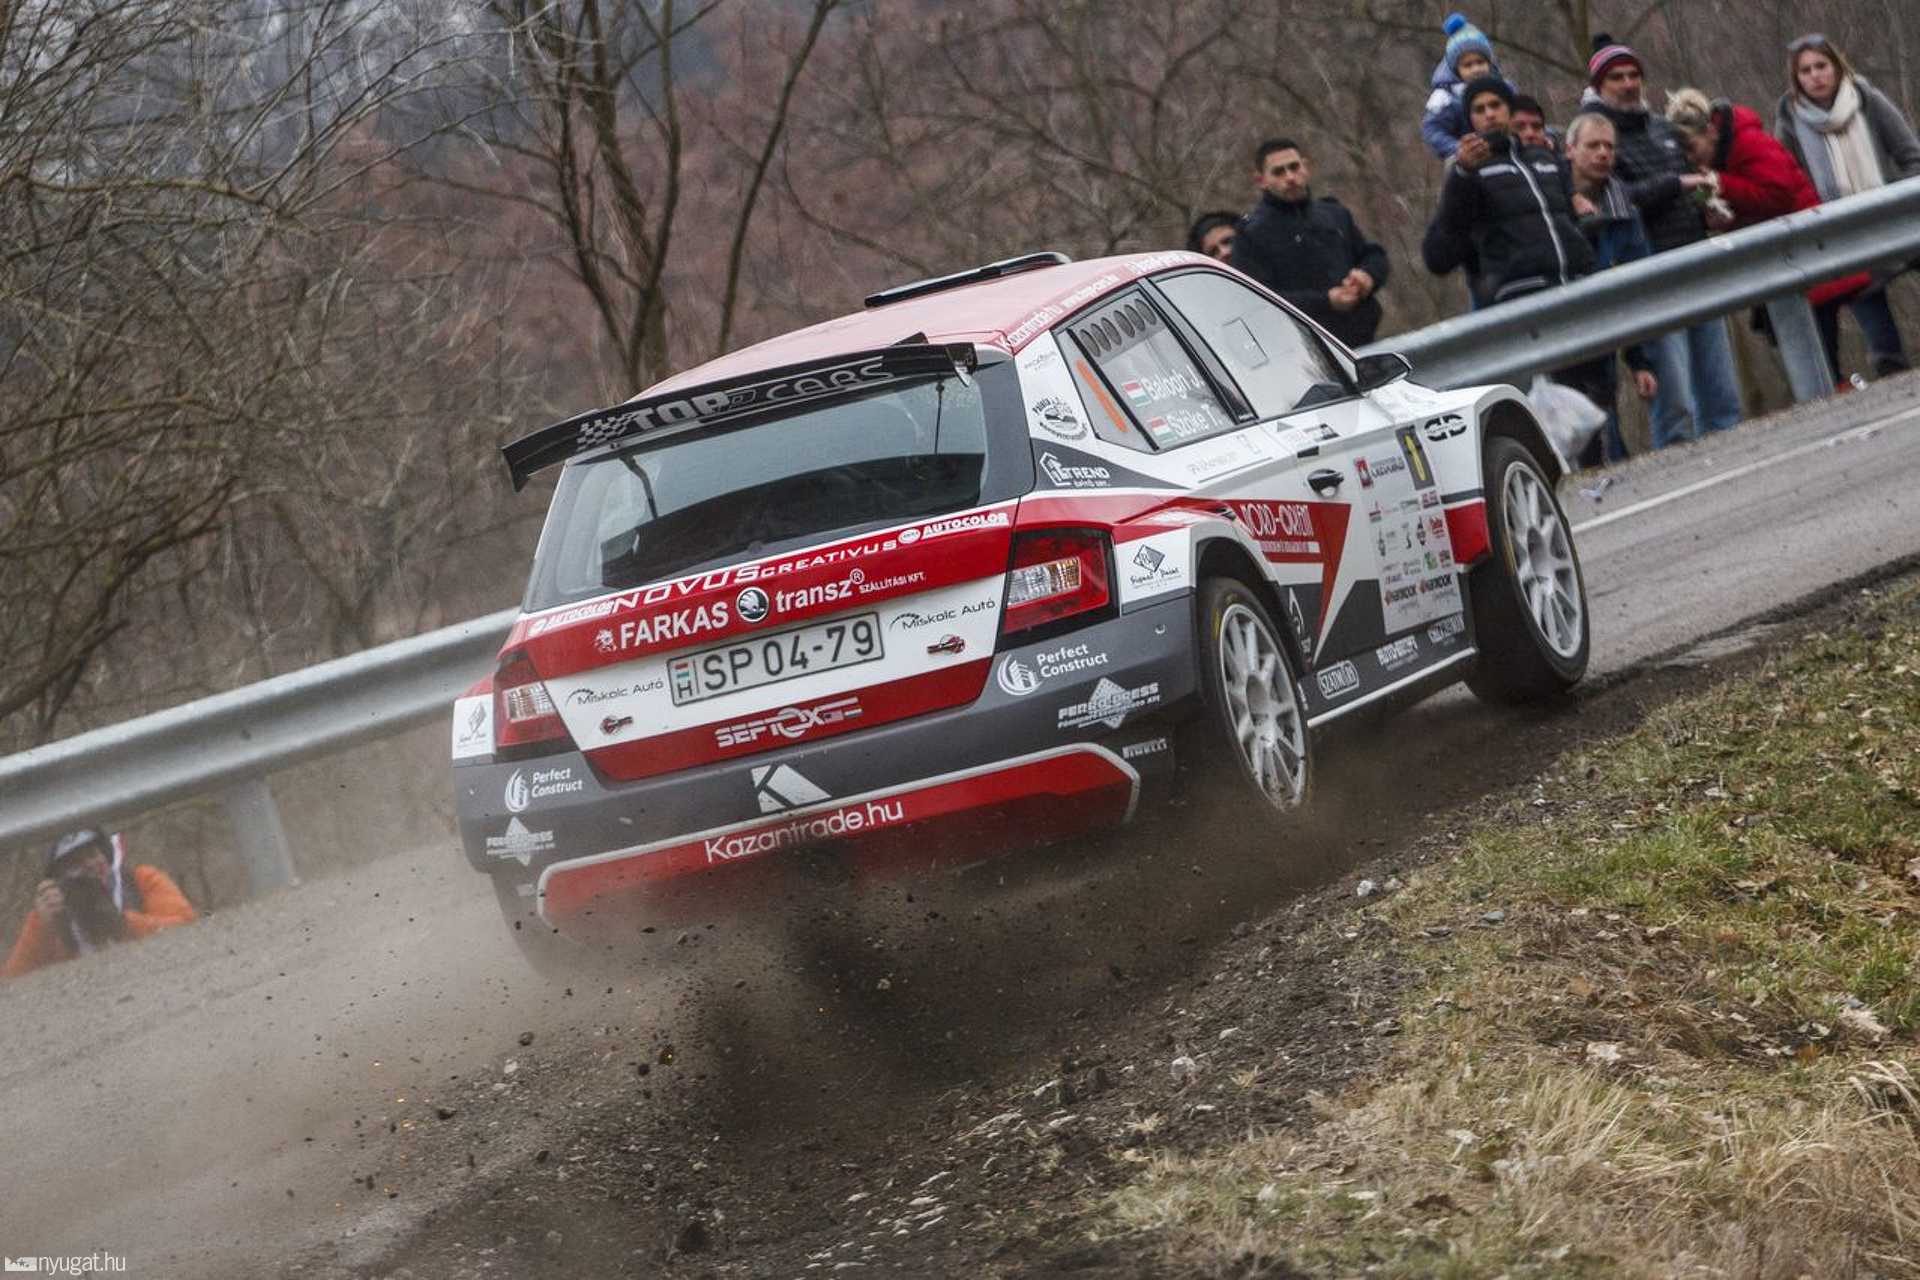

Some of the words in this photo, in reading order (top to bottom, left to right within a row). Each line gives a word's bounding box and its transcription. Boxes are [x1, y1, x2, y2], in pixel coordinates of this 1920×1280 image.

[765, 361, 895, 402] CARS
[1144, 369, 1188, 402] Balogh
[612, 564, 762, 614] NOVUS
[761, 539, 897, 578] CREATIVUS
[921, 511, 1010, 541] AUTOCOLOR
[620, 601, 730, 650] FARKAS
[902, 608, 957, 630] Miskolc
[961, 597, 996, 616] Autó
[703, 648, 753, 691] SP
[763, 619, 874, 677] 04-79
[1036, 643, 1089, 665] Perfect
[1040, 653, 1109, 678] Construct
[577, 687, 628, 705] Miskolc
[632, 678, 664, 696] Autó
[531, 780, 583, 799] Construct
[533, 768, 571, 784] Perfect
[704, 801, 905, 864] Kazantrade.hu
